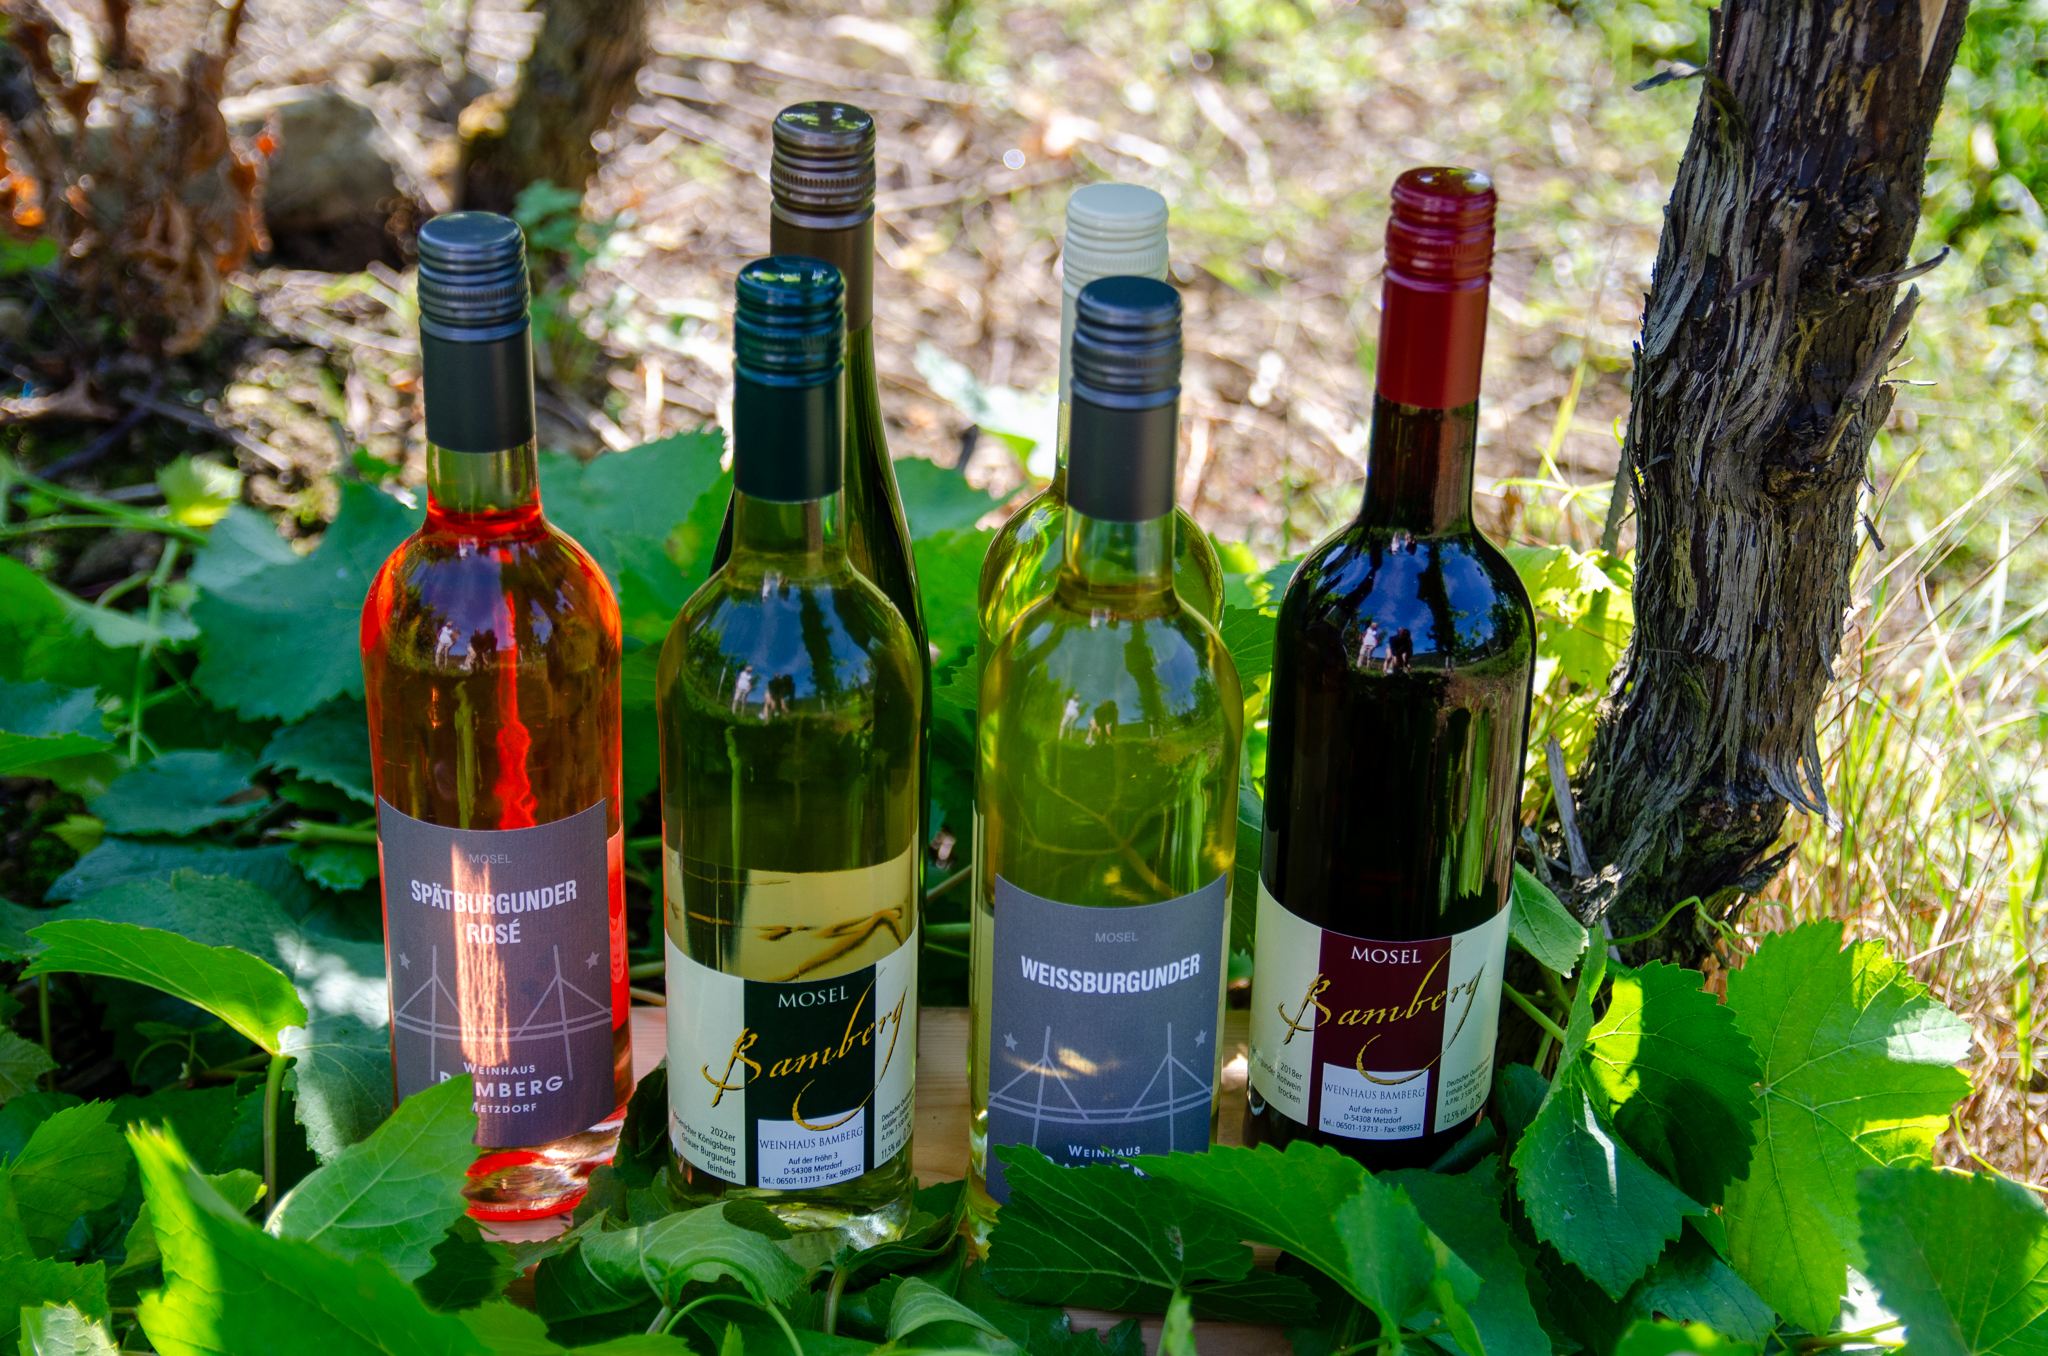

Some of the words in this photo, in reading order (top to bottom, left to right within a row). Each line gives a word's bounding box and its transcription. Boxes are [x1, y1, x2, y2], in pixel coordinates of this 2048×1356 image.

[468, 853, 512, 864] MOSEL
[410, 879, 577, 915] SPÄTBURGUNDER
[466, 918, 521, 945] ROSÉ
[1095, 932, 1139, 943] MOSEL
[1350, 946, 1422, 964] MOSEL
[1020, 953, 1201, 994] WEISSBURGUNDER
[778, 985, 849, 1008] MOSEL
[1278, 939, 1487, 1085] Bamberg
[701, 966, 908, 1131] Bamberg
[463, 1061, 536, 1076] WEINHAUS
[1280, 1062, 1303, 1081] 2018er
[440, 1070, 563, 1098] BMBERG
[1324, 1082, 1377, 1099] WEINHAUS
[1380, 1087, 1425, 1100] BAMBERG
[1343, 1113, 1371, 1123] D-54308
[1372, 1116, 1402, 1124] Metzdorf
[1348, 1105, 1361, 1113] Auf
[1361, 1106, 1372, 1114] der
[1374, 1106, 1392, 1115] Fröhn
[1393, 1107, 1398, 1115] 3
[710, 1126, 736, 1142] 2022er
[1335, 1121, 1378, 1133] 06501-13713
[1397, 1123, 1421, 1133] 989532
[698, 1131, 736, 1157] Königsberg
[759, 1138, 816, 1150] WEINHAUS
[819, 1126, 863, 1147] BAMBERG
[681, 1132, 699, 1152] Grauer
[700, 1145, 736, 1167] Burgunder
[788, 1157, 800, 1165] Auf
[814, 1153, 833, 1162] Fröhn
[833, 1151, 838, 1159] 3
[707, 1160, 736, 1179] feinherb
[776, 1175, 820, 1185] 06501-13713
[825, 1172, 838, 1180] Fax:
[839, 1164, 862, 1177] 989532
[783, 1165, 812, 1175] D-54308
[814, 1160, 843, 1173] Metzdorf
